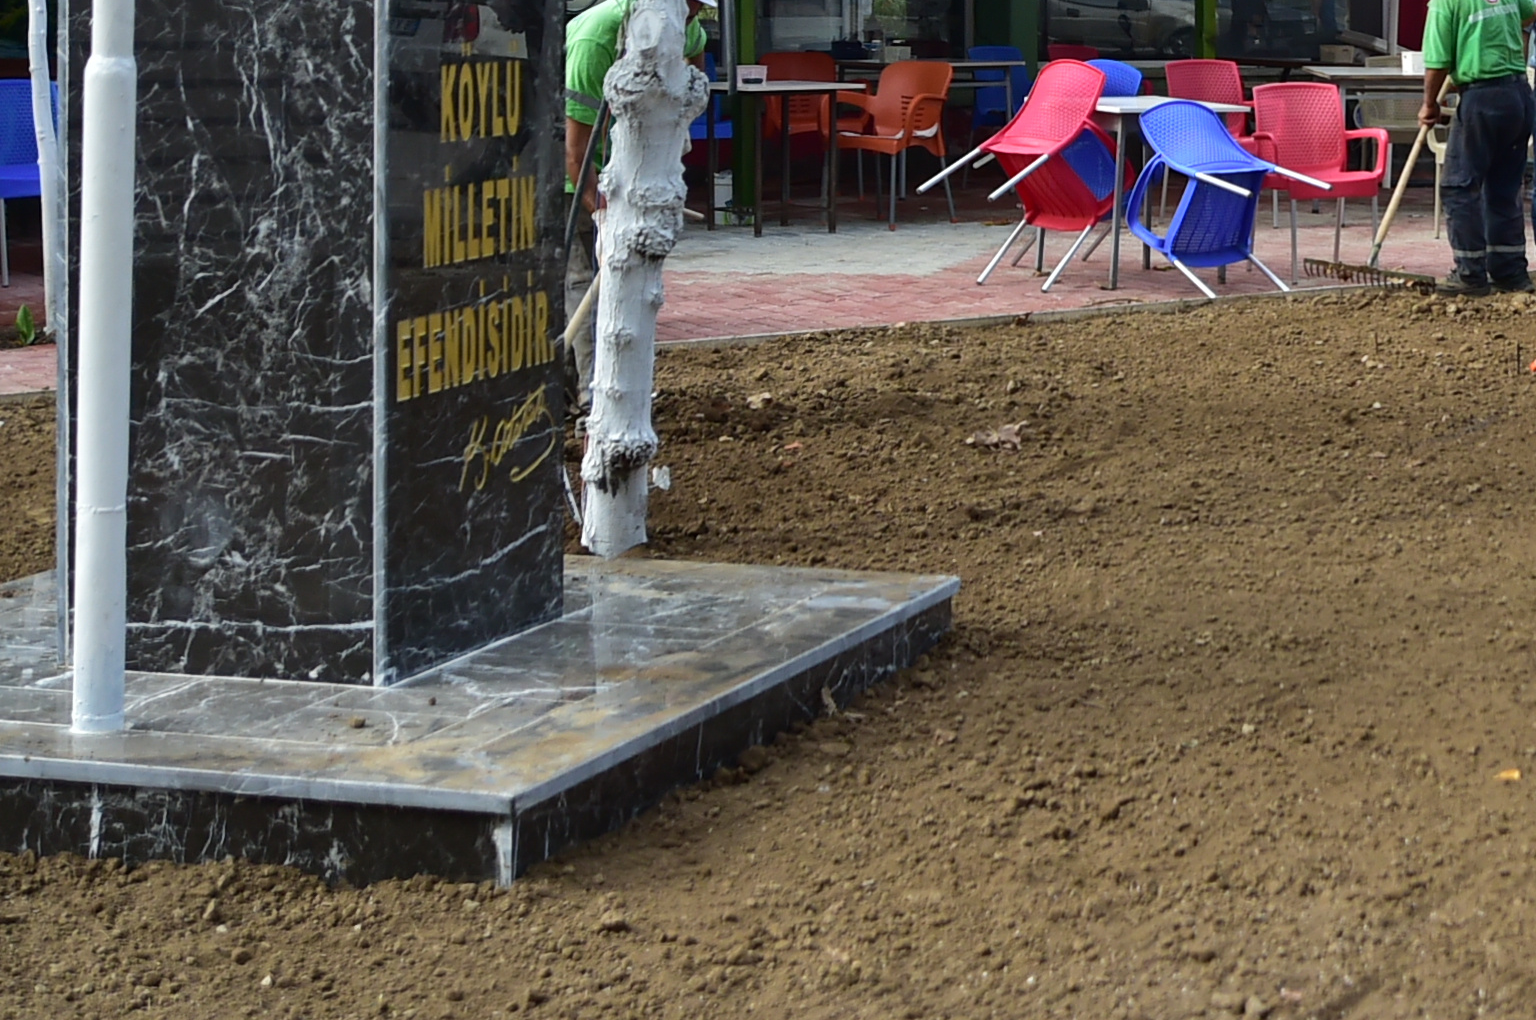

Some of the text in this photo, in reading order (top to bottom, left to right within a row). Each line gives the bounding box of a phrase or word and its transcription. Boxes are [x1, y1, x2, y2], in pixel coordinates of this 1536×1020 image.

[440, 40, 521, 143] KÖYLÜ
[423, 156, 536, 269] MİLLETİN
[396, 269, 556, 403] EFENDİSİDİR.
